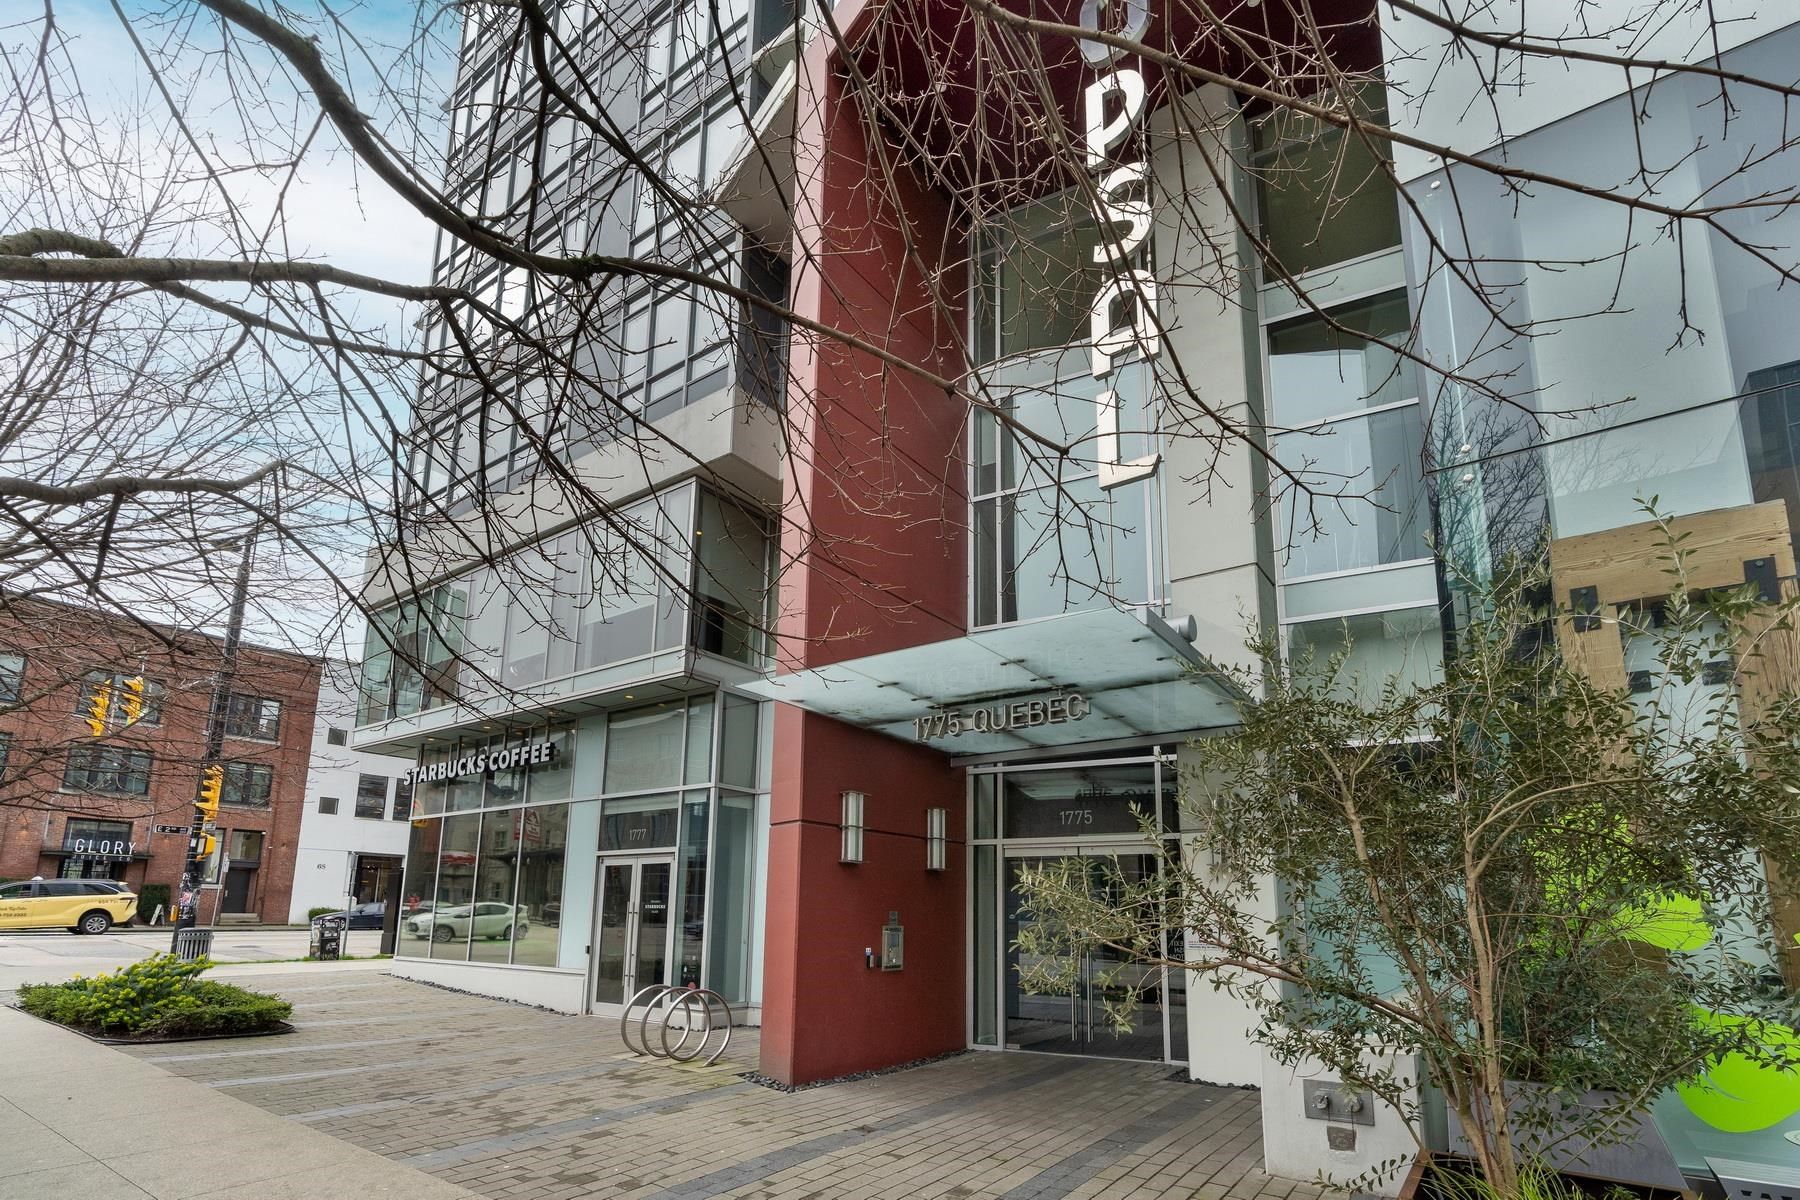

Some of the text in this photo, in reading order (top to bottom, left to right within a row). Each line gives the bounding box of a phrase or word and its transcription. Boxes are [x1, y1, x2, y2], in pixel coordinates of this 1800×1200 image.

[1079, 0, 1161, 490] OPSAL
[913, 693, 1086, 743] 1775 QUEBEC
[403, 742, 553, 786] STARBUCKS COFFEE
[1059, 810, 1093, 825] 1775
[74, 838, 137, 855] GLORY
[629, 827, 647, 841] 1777
